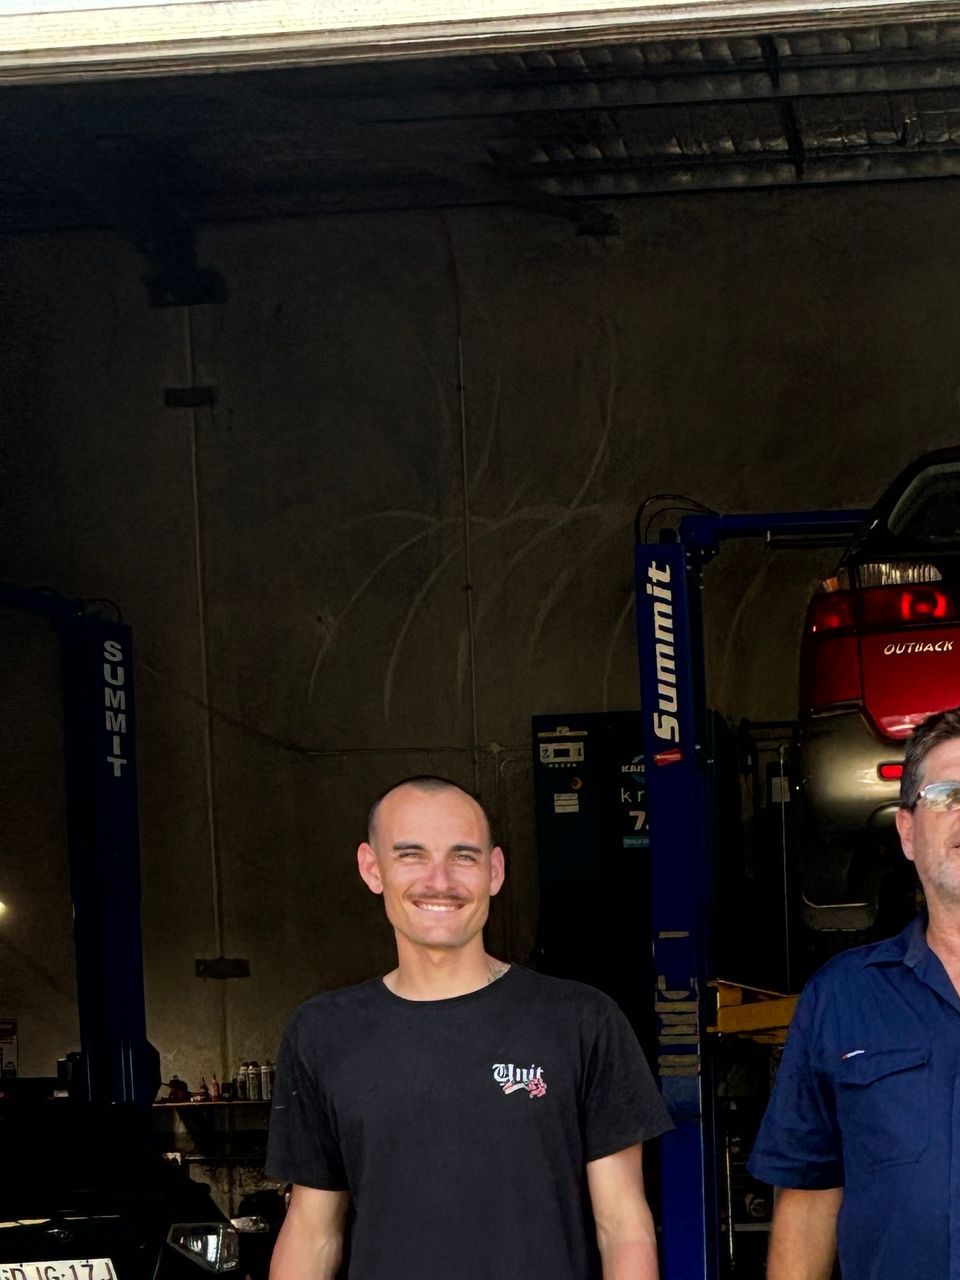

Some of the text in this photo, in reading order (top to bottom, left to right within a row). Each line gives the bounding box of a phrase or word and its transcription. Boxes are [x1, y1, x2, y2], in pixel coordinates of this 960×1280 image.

[646, 560, 680, 743] Summit
[883, 641, 955, 655] OUTBACK
[103, 639, 128, 777] SUMMIT
[492, 1063, 544, 1083] Unit
